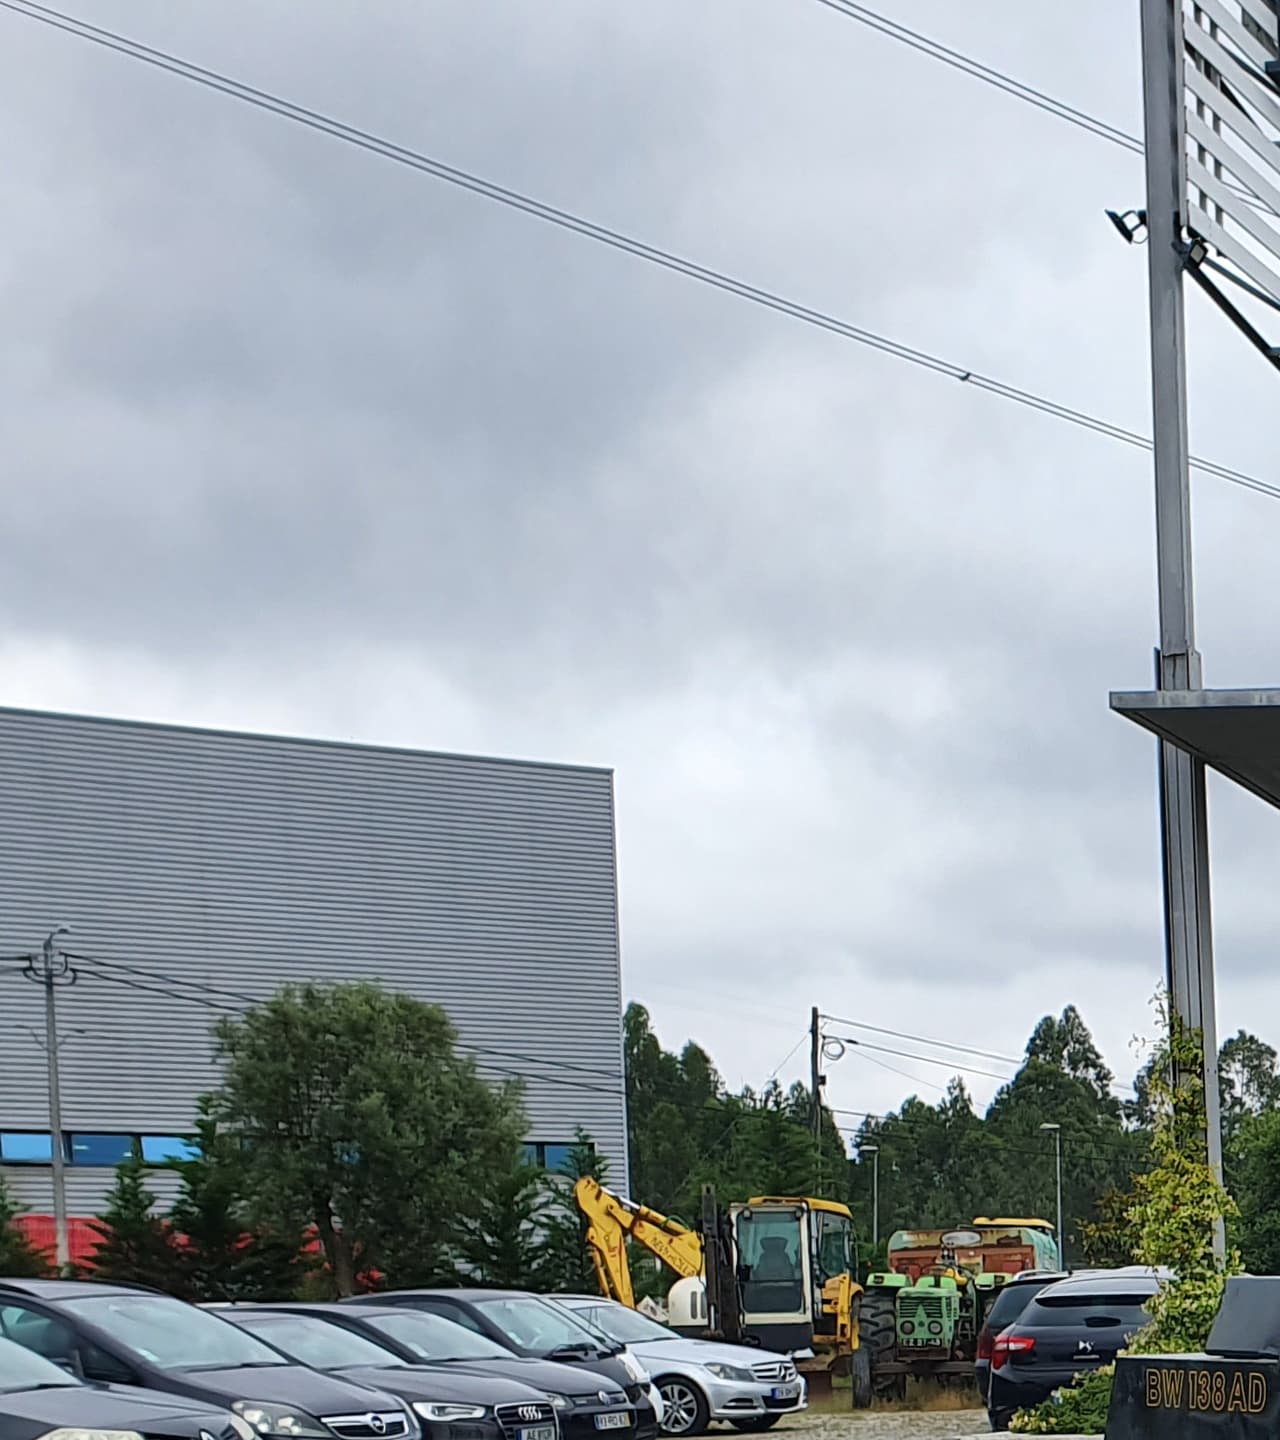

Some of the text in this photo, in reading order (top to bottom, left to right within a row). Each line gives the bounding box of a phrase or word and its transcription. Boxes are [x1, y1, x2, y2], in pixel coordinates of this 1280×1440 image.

[1146, 1368, 1266, 1412] BW 138 AD
